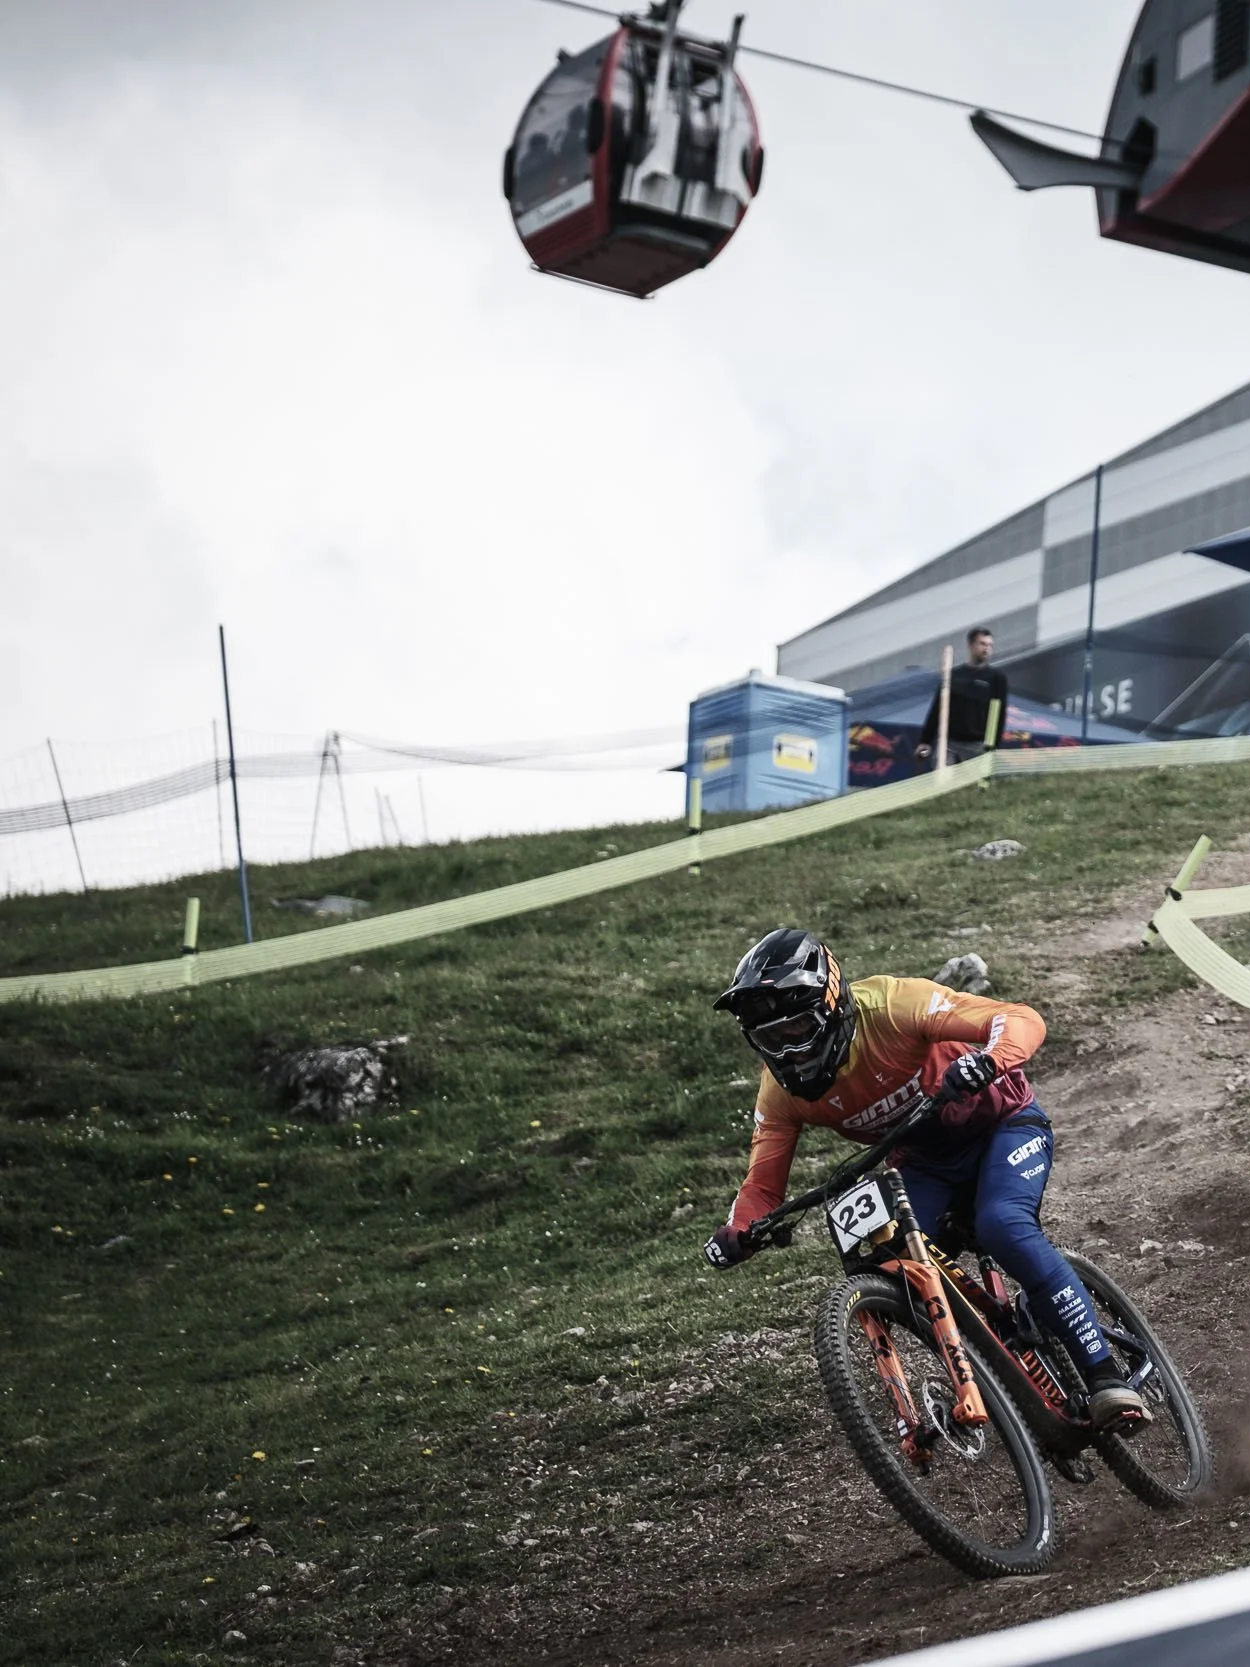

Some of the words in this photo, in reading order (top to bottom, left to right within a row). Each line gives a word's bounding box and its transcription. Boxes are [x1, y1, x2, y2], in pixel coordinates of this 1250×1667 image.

[843, 1067, 922, 1128] GIANT
[839, 1193, 876, 1234] 23
[1051, 1285, 1075, 1304] FOX
